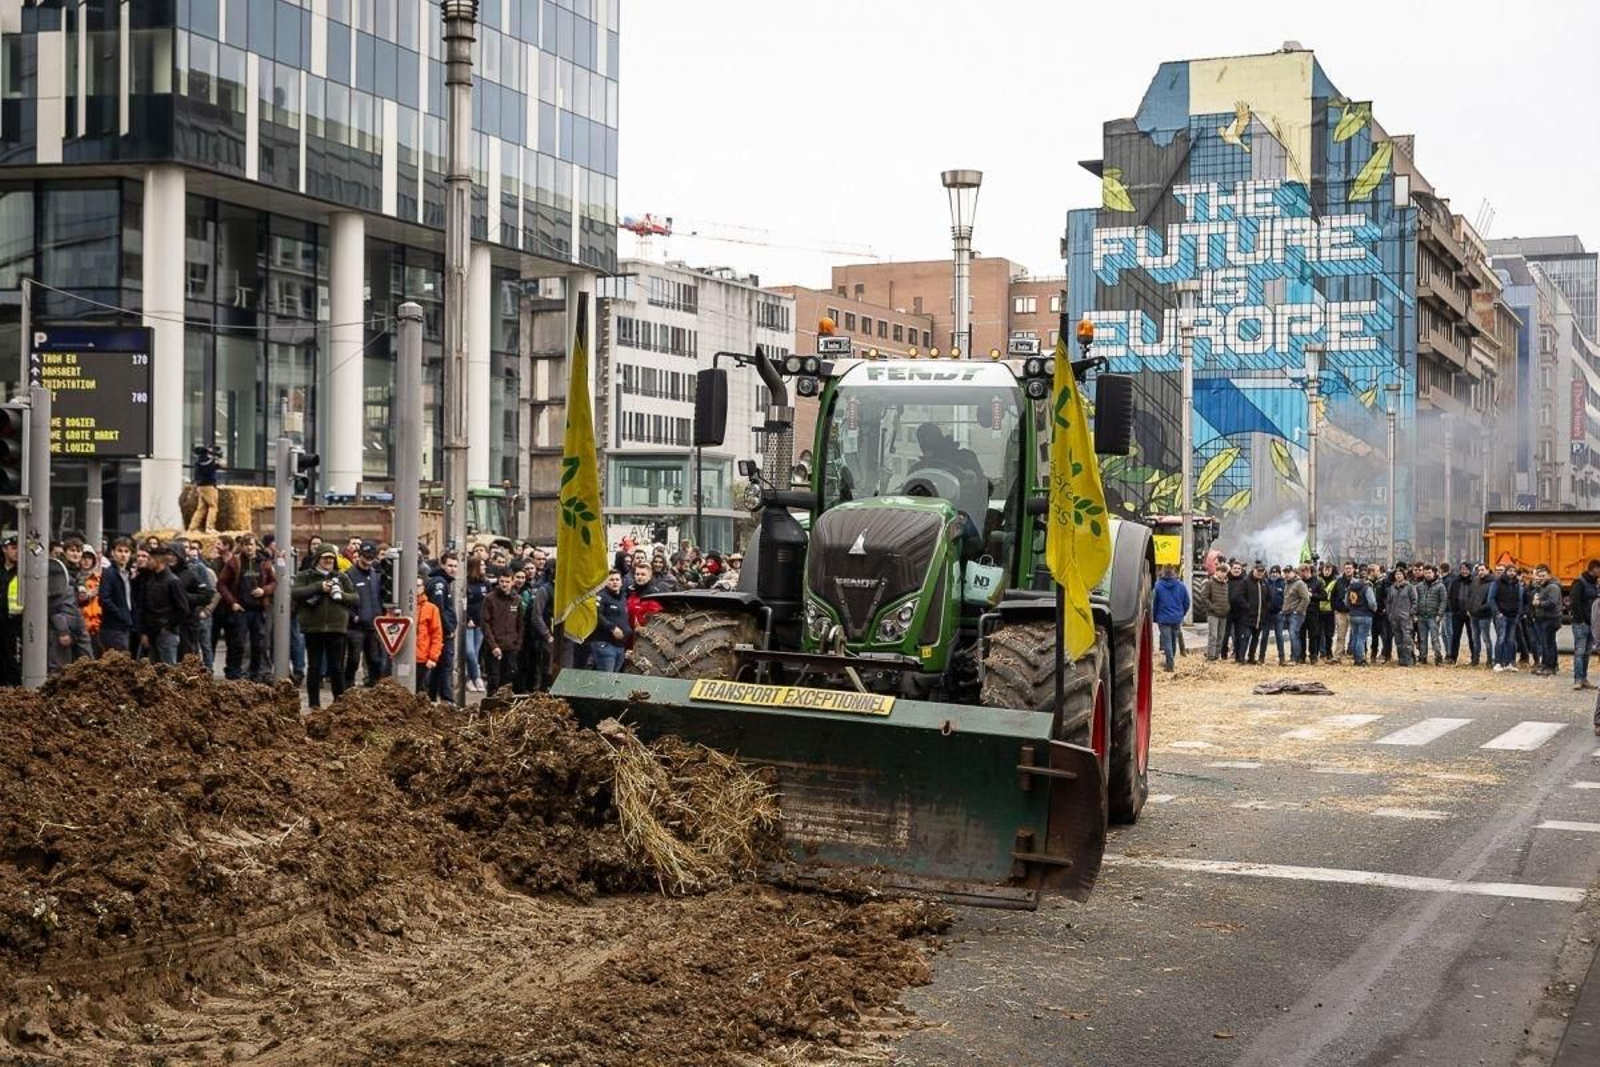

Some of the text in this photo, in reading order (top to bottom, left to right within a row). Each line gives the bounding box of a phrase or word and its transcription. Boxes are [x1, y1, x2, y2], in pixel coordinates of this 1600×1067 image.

[1173, 180, 1281, 221] THE
[1092, 213, 1366, 272] FUTURE
[1201, 267, 1249, 305] IS
[1083, 300, 1377, 357] EUROPE
[34, 332, 48, 349] P
[132, 354, 148, 365] 170
[42, 366, 81, 376] DANSAERT
[867, 366, 985, 381] FENDT
[65, 417, 95, 428] ROGIER
[65, 430, 90, 440] GROTE
[94, 430, 120, 441] MARKT
[65, 442, 95, 453] LOUIZA
[696, 681, 885, 713] TRANSPORT EXCEPTIONNEL
